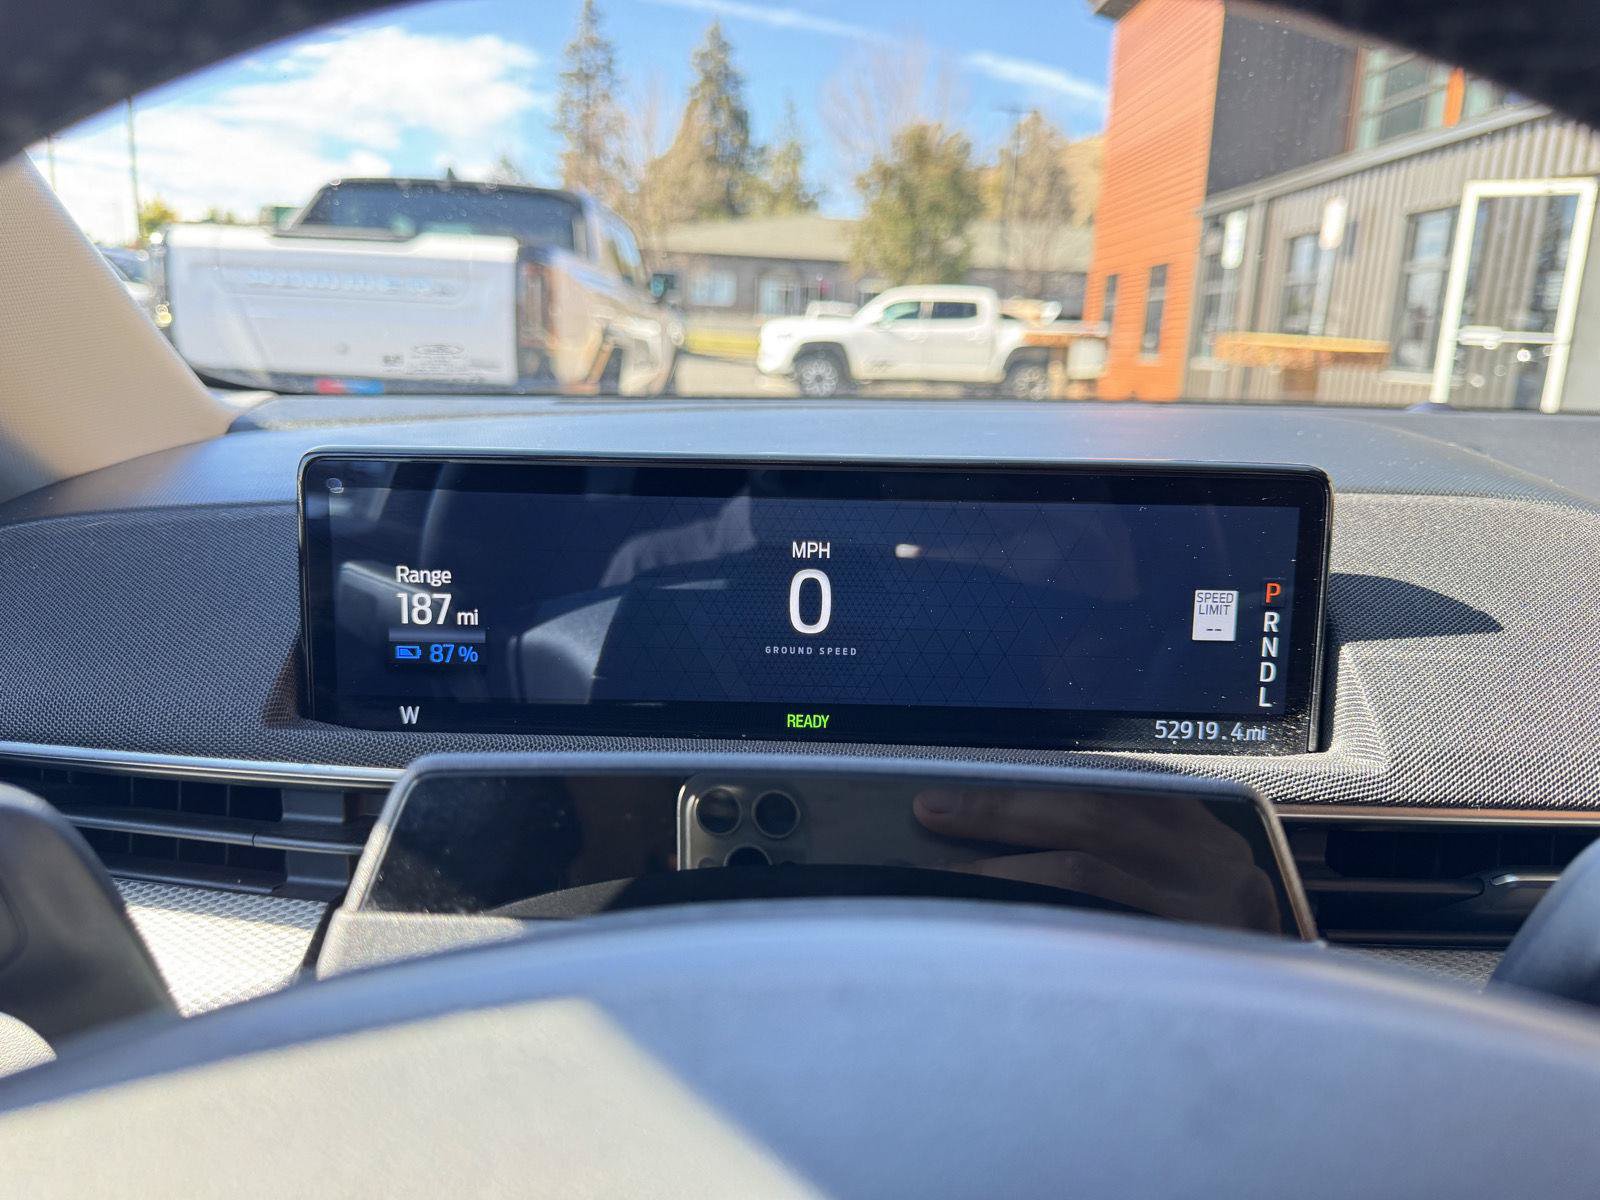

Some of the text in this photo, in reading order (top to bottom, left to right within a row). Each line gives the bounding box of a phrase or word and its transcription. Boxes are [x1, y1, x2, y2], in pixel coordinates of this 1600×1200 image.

[792, 542, 831, 559] MPH
[395, 565, 452, 587] Range
[789, 568, 832, 635] 0
[1196, 592, 1234, 604] SPEED
[396, 592, 479, 626] 187 mi
[1198, 604, 1231, 615] LIMIT
[765, 646, 857, 656] GROUND SPEED
[1258, 582, 1282, 708] P R N D L
[399, 705, 420, 725] W
[786, 714, 830, 729] READY
